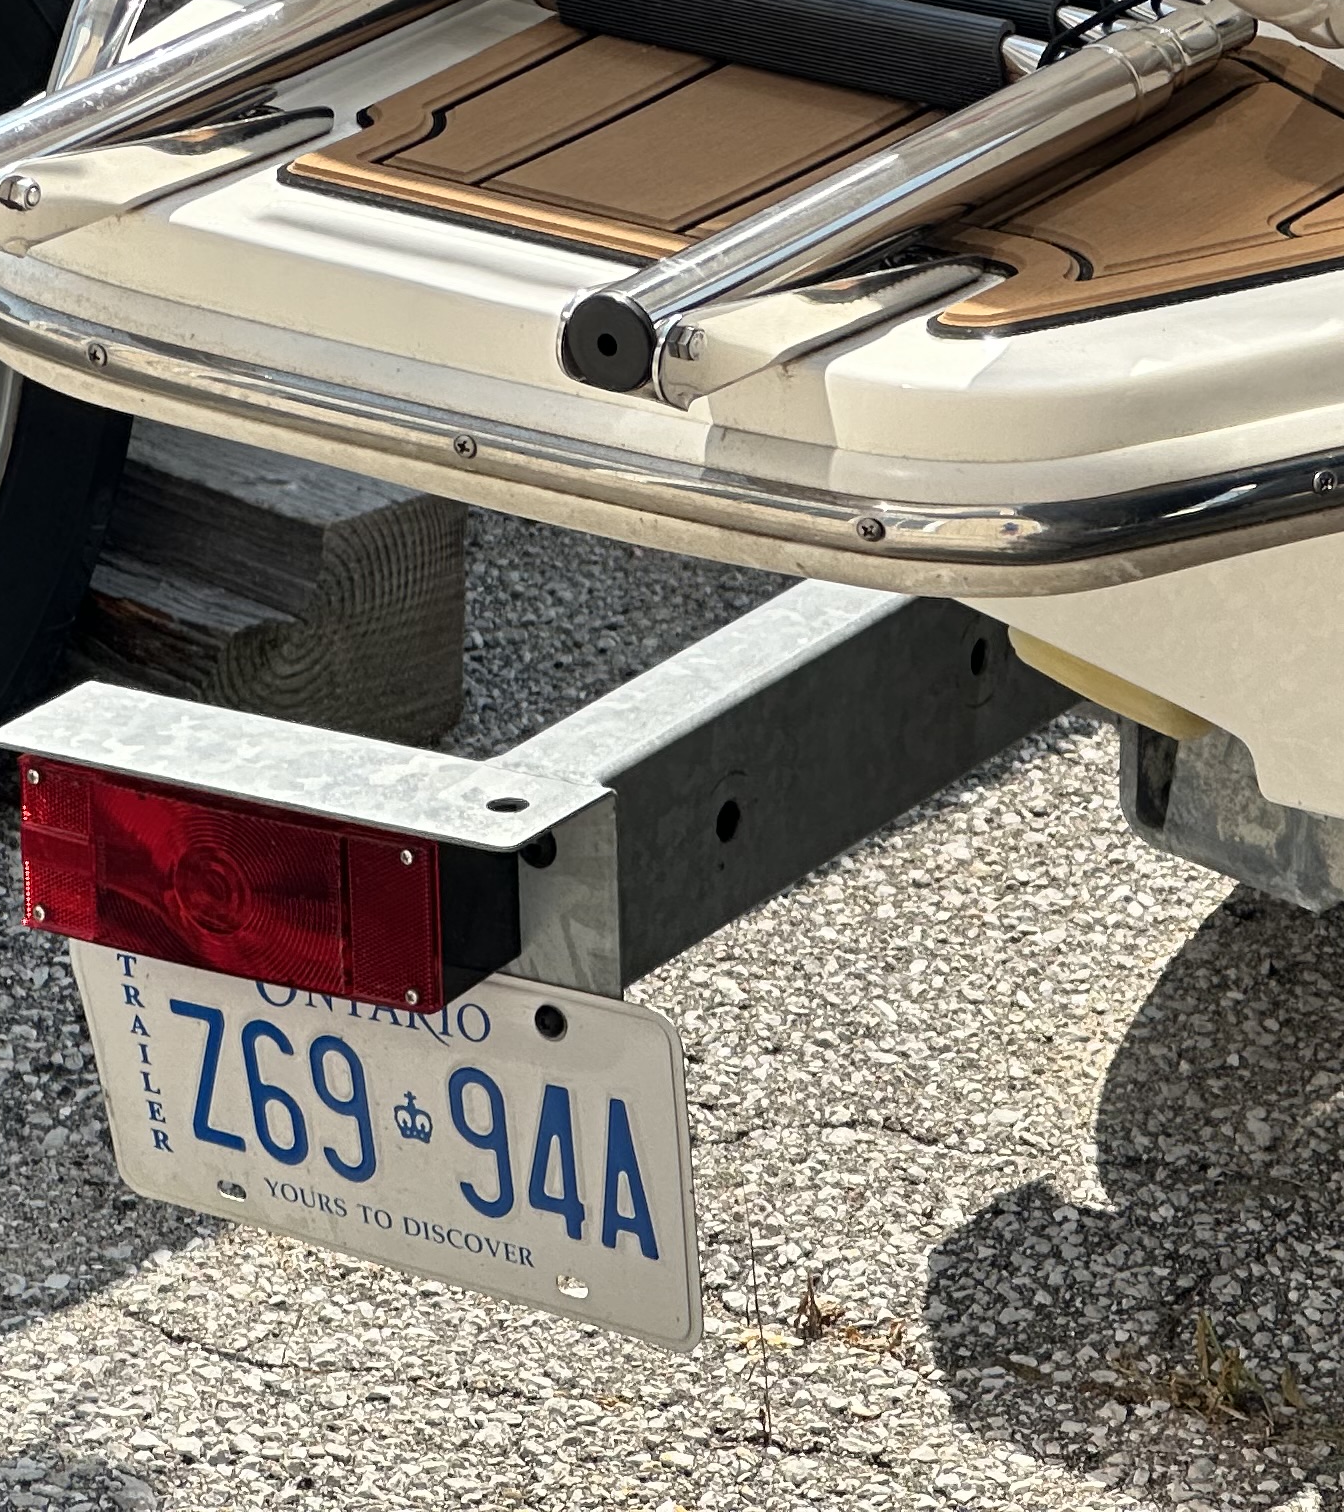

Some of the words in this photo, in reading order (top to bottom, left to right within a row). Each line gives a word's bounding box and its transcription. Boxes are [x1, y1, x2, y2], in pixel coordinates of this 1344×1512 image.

[117, 953, 173, 1153] TRAILER
[169, 999, 377, 1183] Z69
[448, 1066, 660, 1261] 94A
[263, 1178, 349, 1217] YOURS
[356, 1202, 394, 1231] TO
[403, 1216, 536, 1268] DISCOVER
